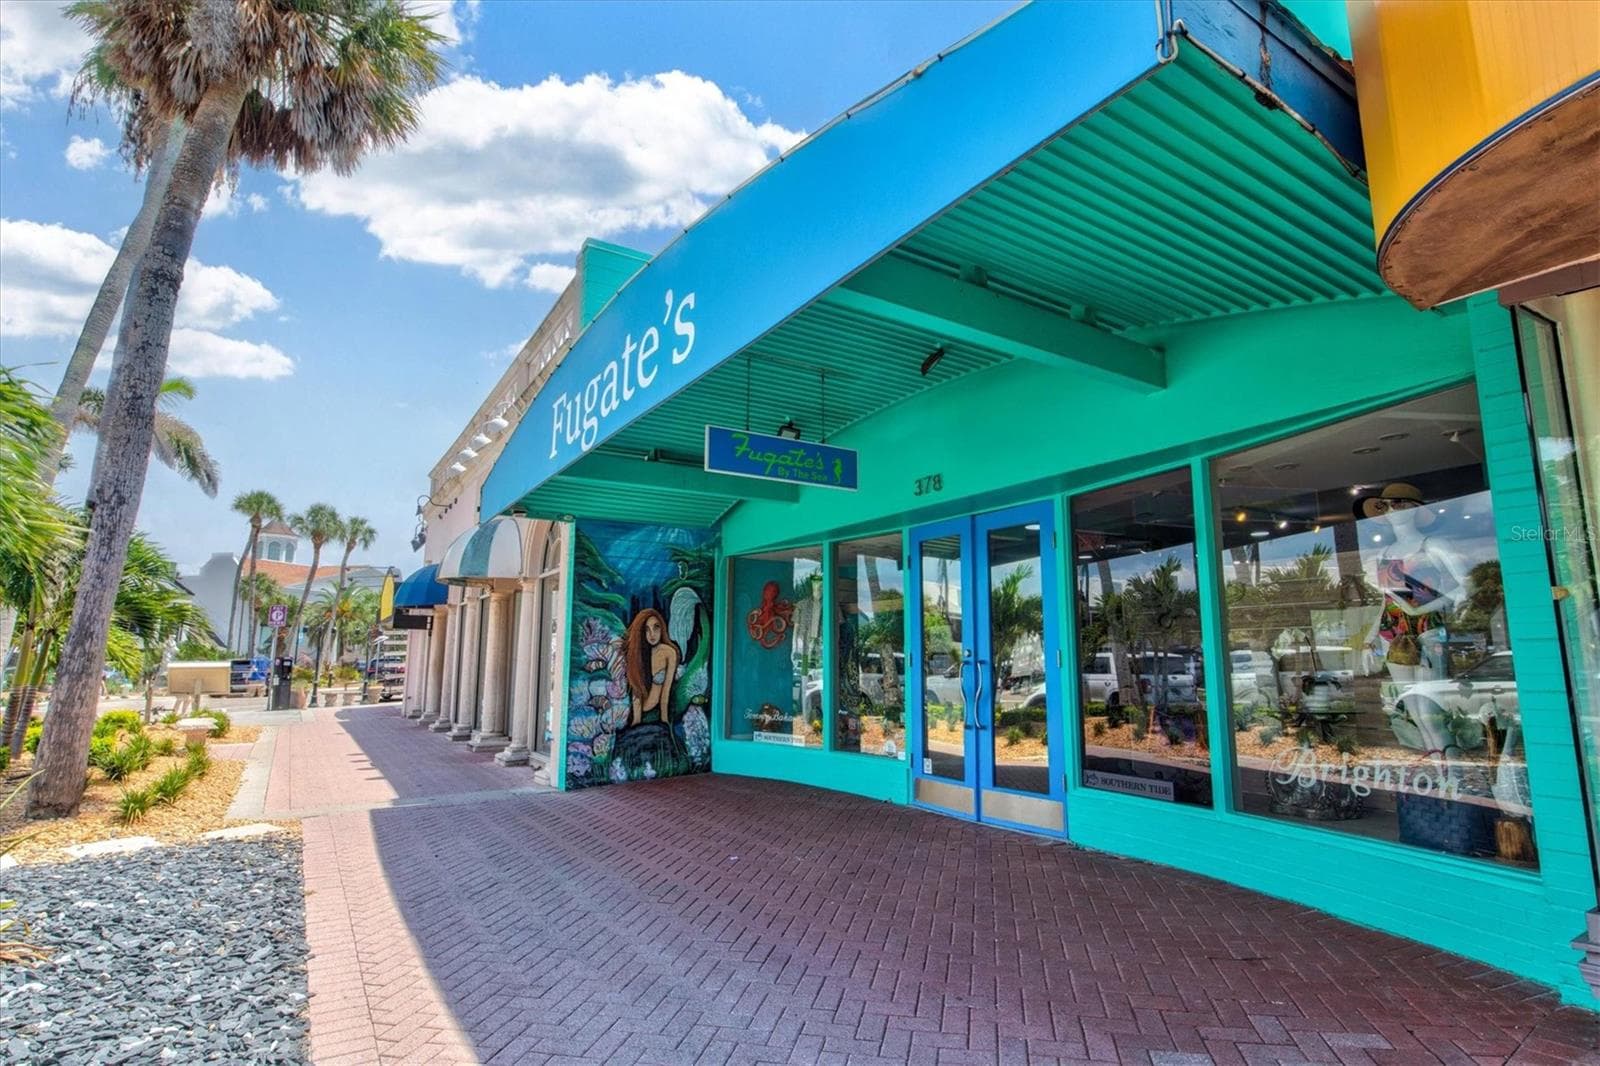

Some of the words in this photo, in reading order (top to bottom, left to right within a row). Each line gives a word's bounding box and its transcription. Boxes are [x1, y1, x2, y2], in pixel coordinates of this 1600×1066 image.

[548, 288, 696, 460] Fugate's
[731, 433, 825, 476] Fugate's
[777, 466, 790, 479] By
[792, 468, 810, 479] The
[914, 473, 944, 497] 378
[1100, 777, 1147, 792] SOUTHERN
[1148, 783, 1172, 796] TIDE
[1274, 747, 1463, 801] Brighton
